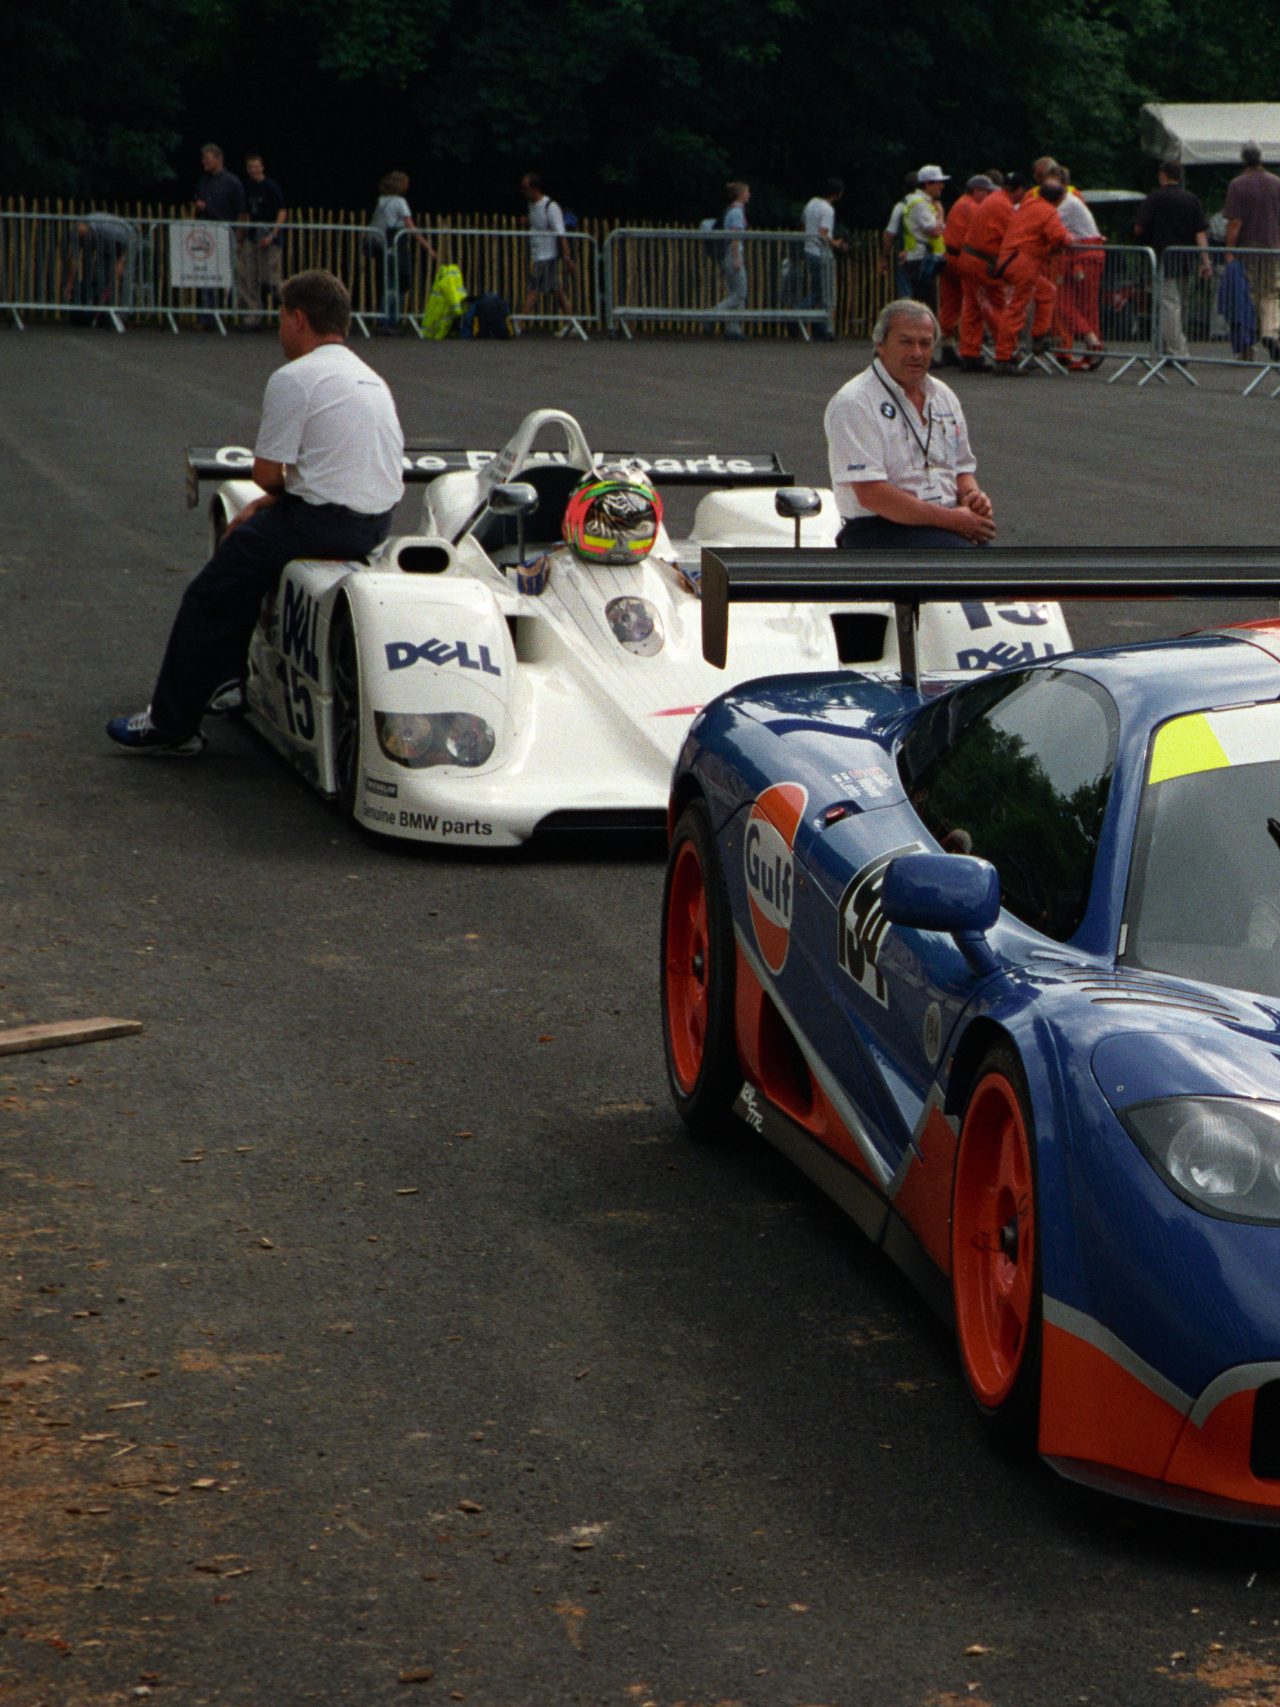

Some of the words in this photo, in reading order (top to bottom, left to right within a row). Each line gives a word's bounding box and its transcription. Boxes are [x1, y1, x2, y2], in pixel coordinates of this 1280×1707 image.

[283, 579, 319, 682] DELL
[384, 638, 501, 677] DELL
[276, 655, 315, 740] 15
[400, 811, 438, 831] BMW
[442, 820, 493, 836] parts
[746, 824, 792, 917] Gulf
